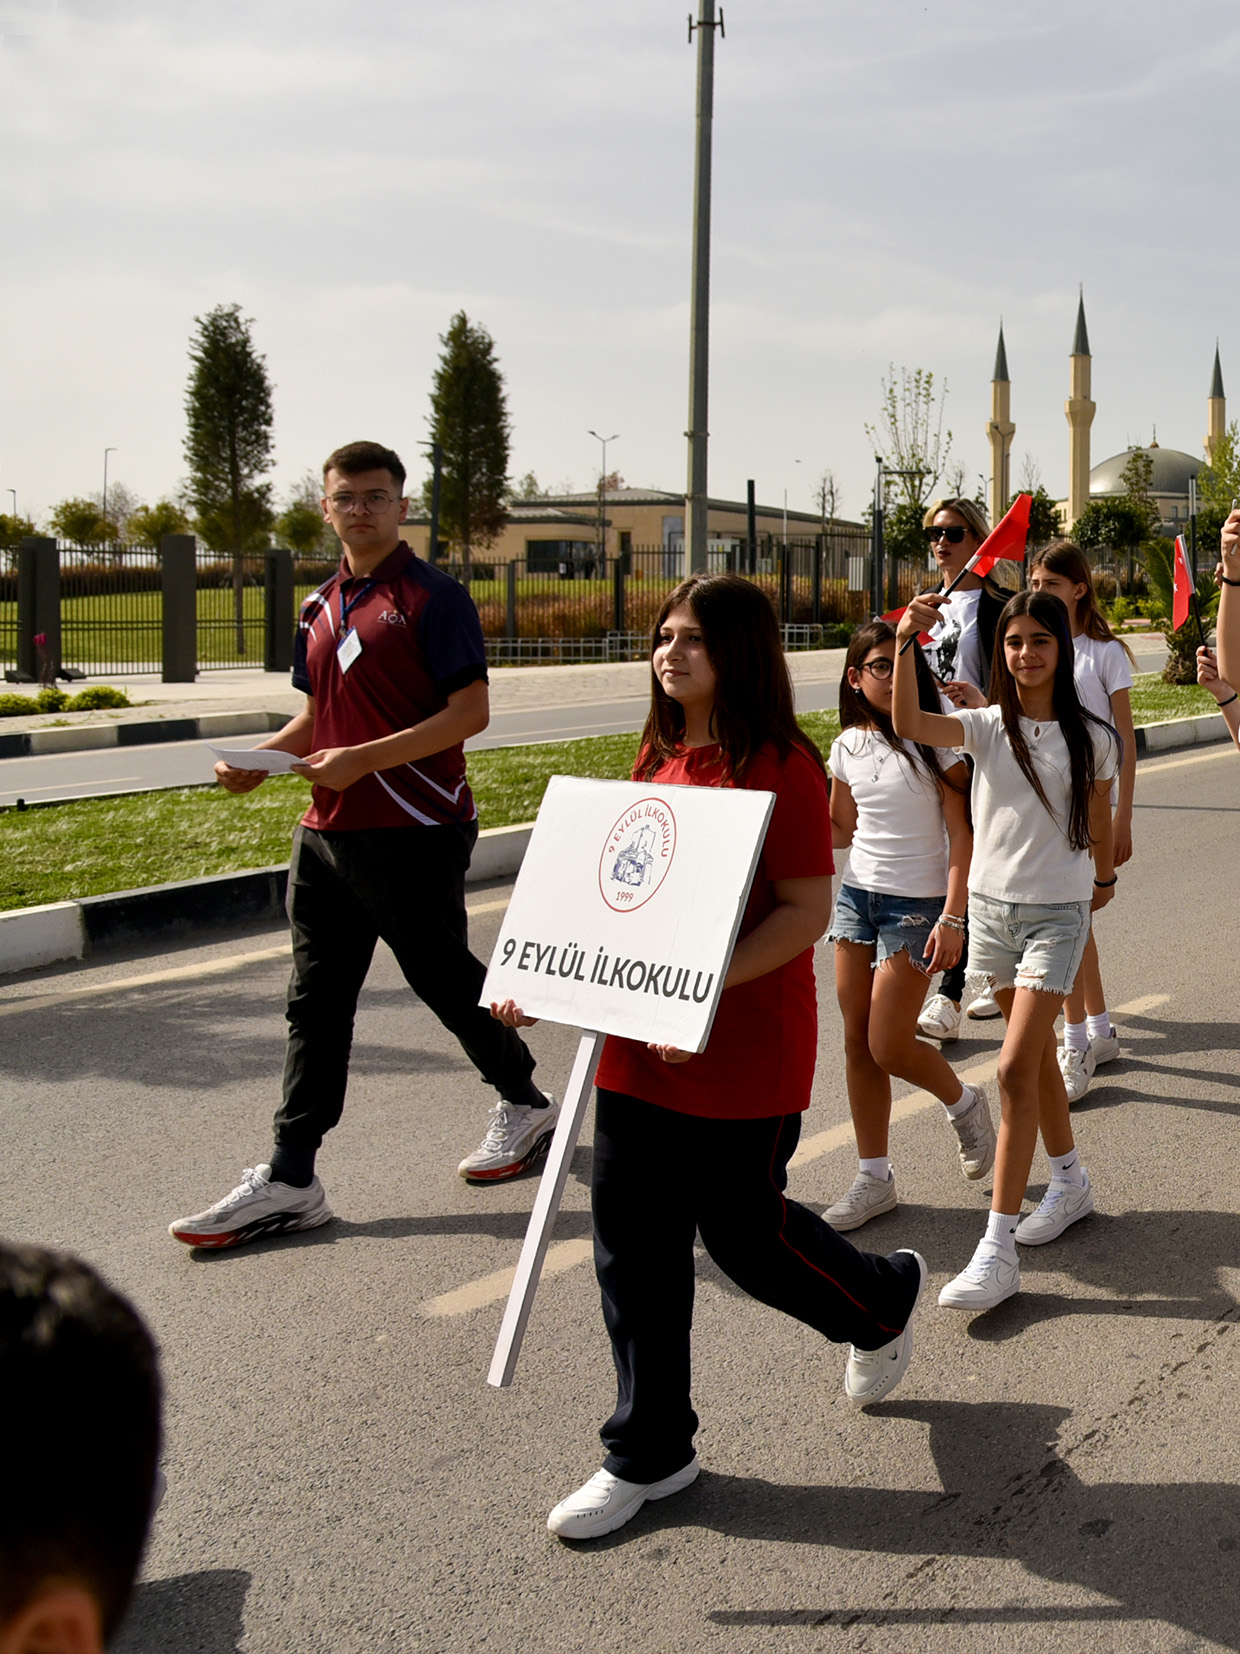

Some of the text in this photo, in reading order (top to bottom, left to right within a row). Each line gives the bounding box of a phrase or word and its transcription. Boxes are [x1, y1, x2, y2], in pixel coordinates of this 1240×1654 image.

[608, 804, 671, 857] 9 EYLÜL İLKOKULU
[616, 891, 634, 902] 1999
[500, 938, 715, 1003] 9 EYLÜL İLKOKULU
